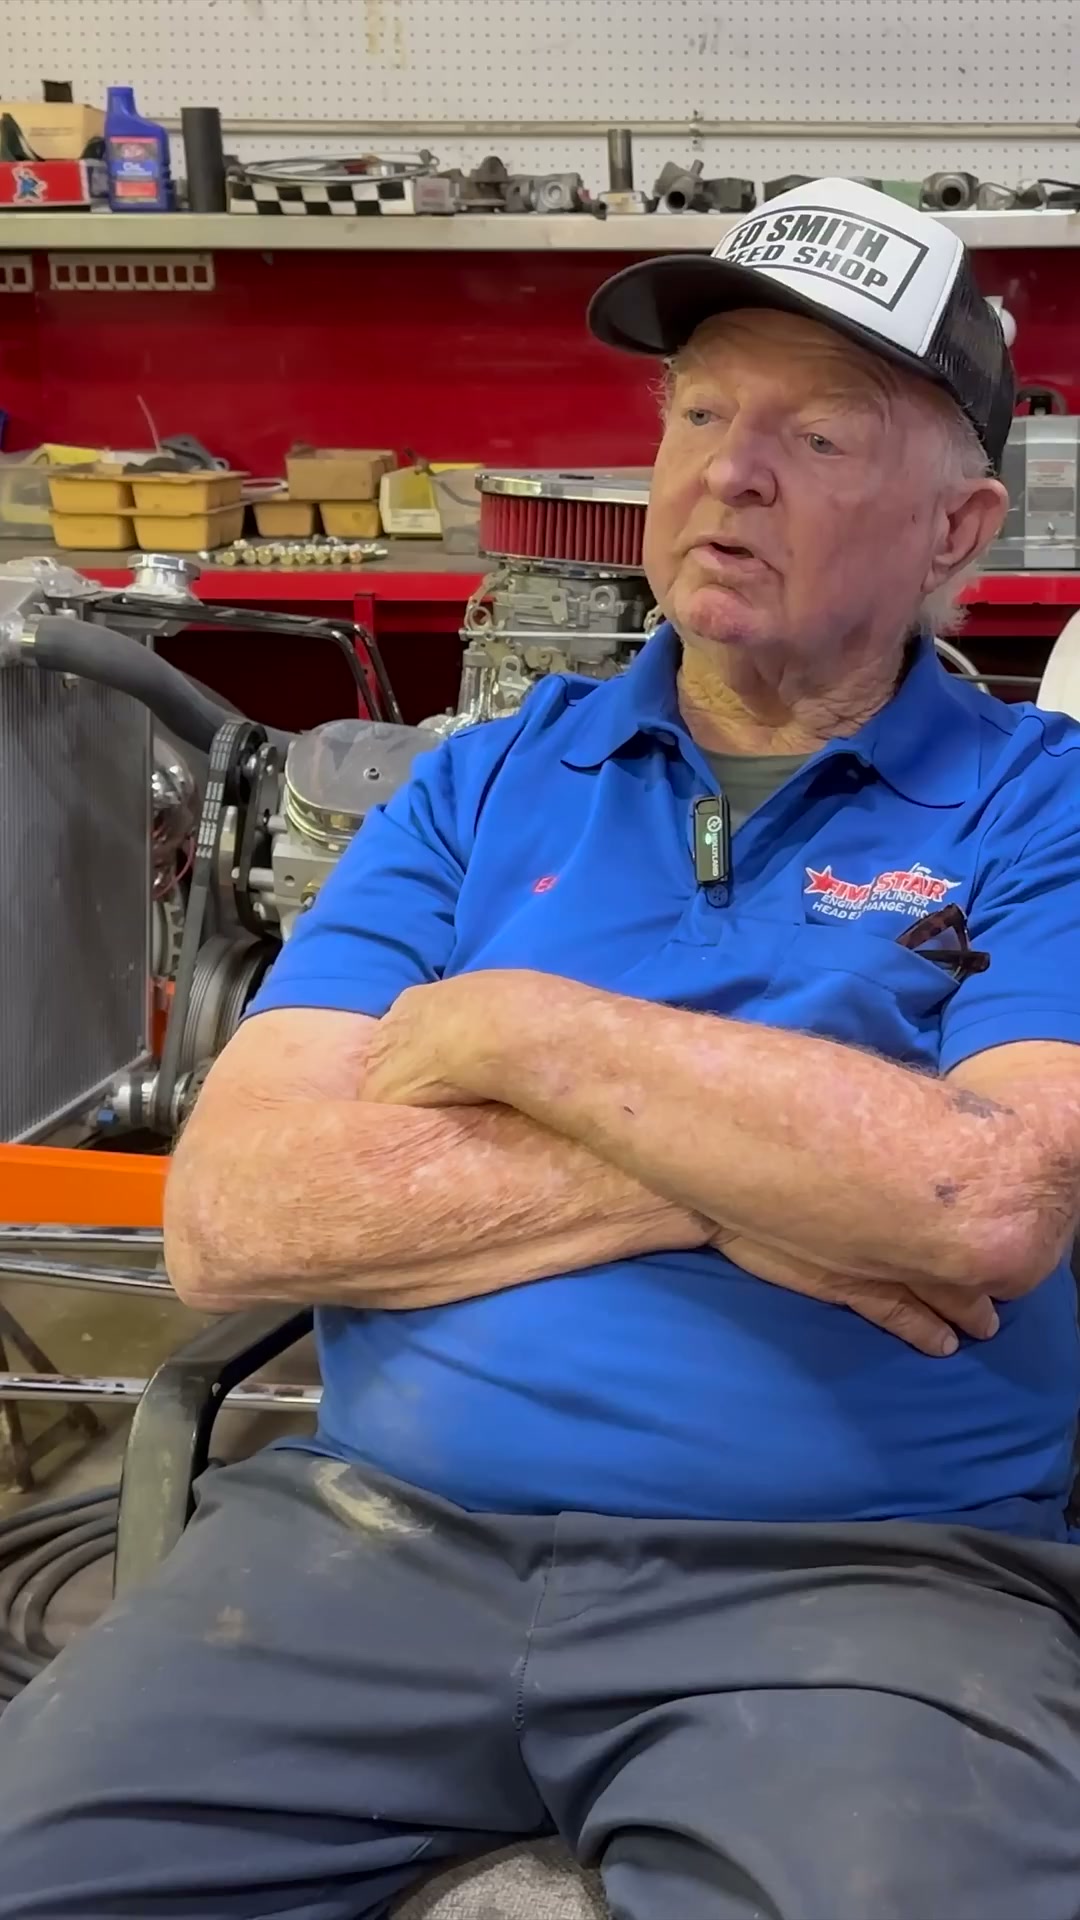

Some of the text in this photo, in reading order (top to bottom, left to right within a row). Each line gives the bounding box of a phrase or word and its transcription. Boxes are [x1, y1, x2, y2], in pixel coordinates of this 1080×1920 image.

[766, 214, 890, 263] SMITH
[793, 246, 889, 288] SHOP
[870, 891, 929, 908] CYLINDER
[873, 871, 948, 902] STAR
[812, 901, 847, 918] HEAD
